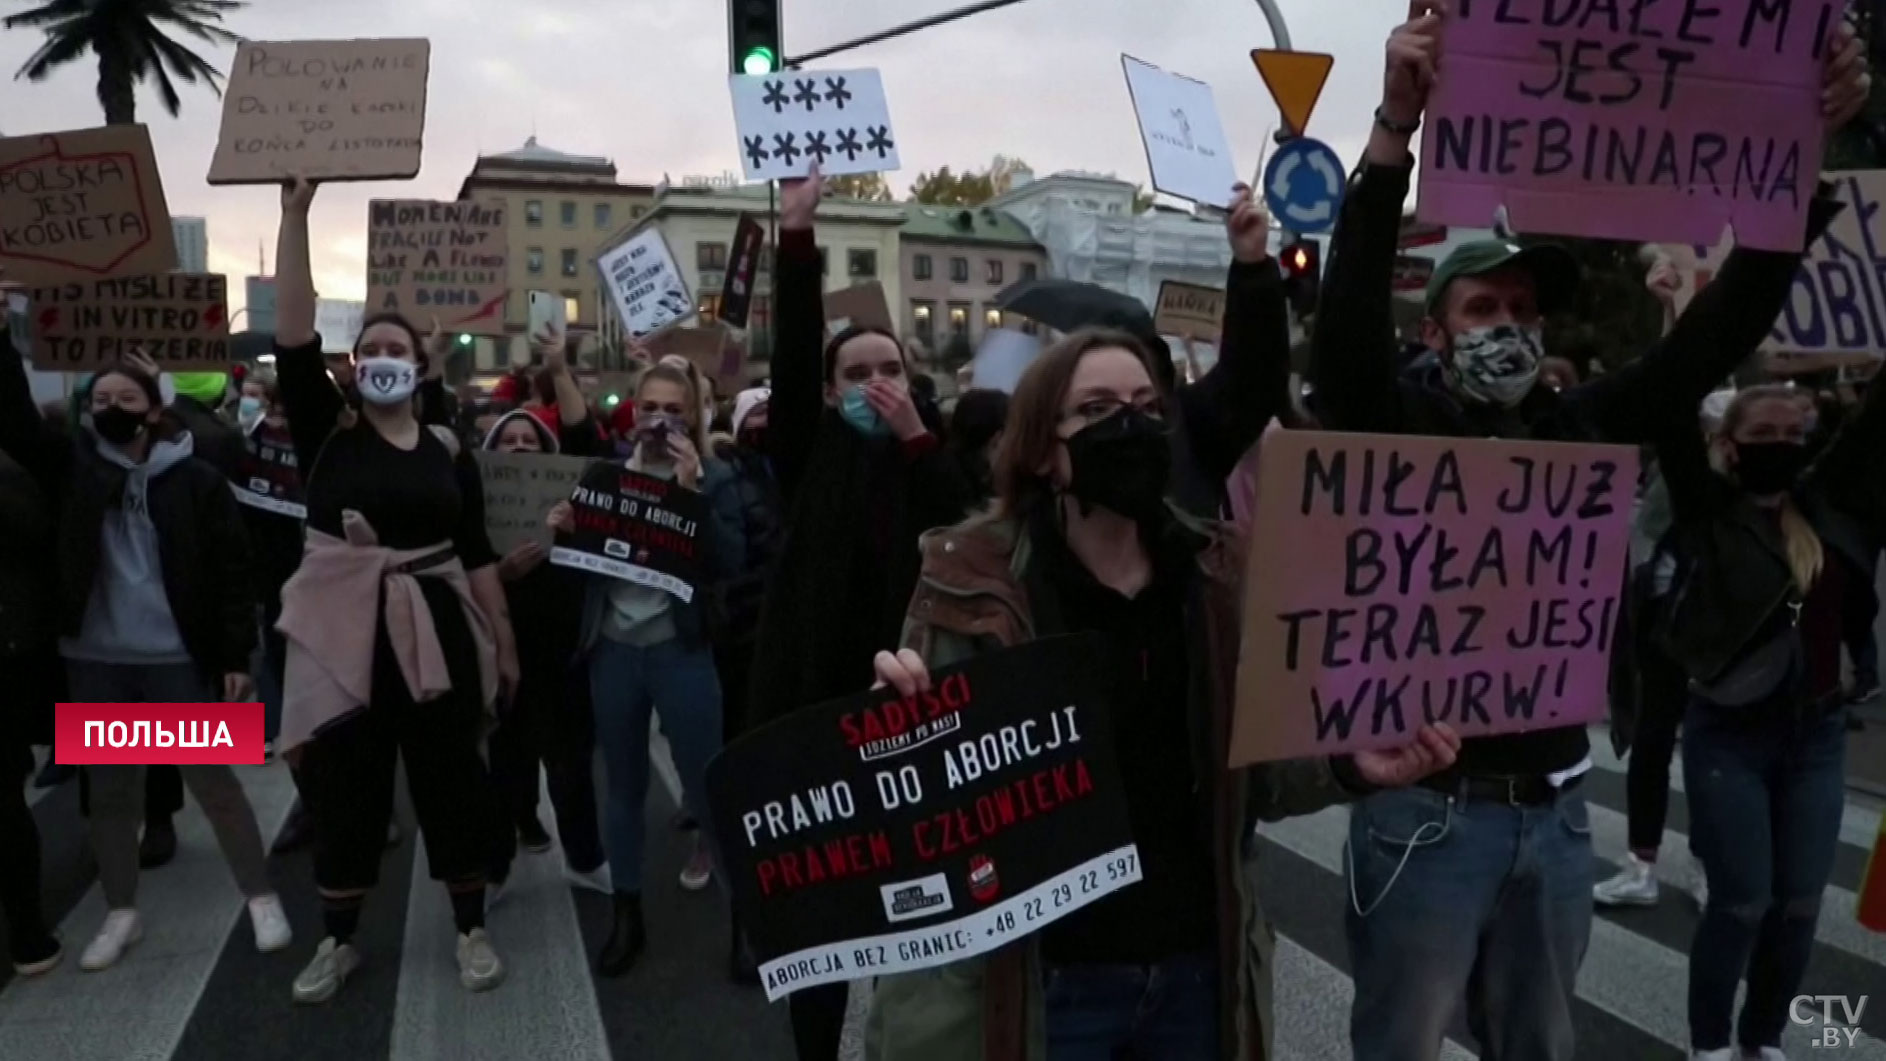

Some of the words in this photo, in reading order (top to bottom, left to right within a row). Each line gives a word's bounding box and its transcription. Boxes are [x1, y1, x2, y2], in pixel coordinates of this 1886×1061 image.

[248, 46, 419, 78] POLOWANIE
[319, 77, 348, 91] NA
[1518, 38, 1696, 110] JEST
[297, 119, 335, 134] DO
[0, 158, 125, 194] POLSKA
[1434, 114, 1799, 212] NIEBINARNA
[2, 210, 144, 247] KOBIETA
[31, 192, 90, 222] JEST
[74, 308, 101, 332] IN
[110, 307, 199, 331] VITRO
[1772, 258, 1886, 348] OBI
[44, 336, 85, 361] TO
[97, 337, 228, 361] PIZZERIA
[620, 498, 638, 517] DO
[1301, 448, 1468, 516] MIŁA
[1343, 523, 1599, 597] BYŁAM!
[1276, 603, 1487, 670] TERAZ
[742, 779, 856, 848] PRAWO
[875, 765, 923, 811] DO
[943, 704, 1081, 790] ABORCJI
[756, 831, 894, 897] PRAWEM
[912, 759, 1095, 860] CZŁOWIEKA
[767, 952, 844, 990] ABORCJA
[853, 945, 888, 968] BEZ
[898, 930, 973, 962] GRANIC:
[986, 911, 1017, 938] +48
[1024, 897, 1045, 921] 22
[1052, 883, 1073, 908] 29
[1079, 870, 1099, 893] 22
[1106, 853, 1136, 881] 597
